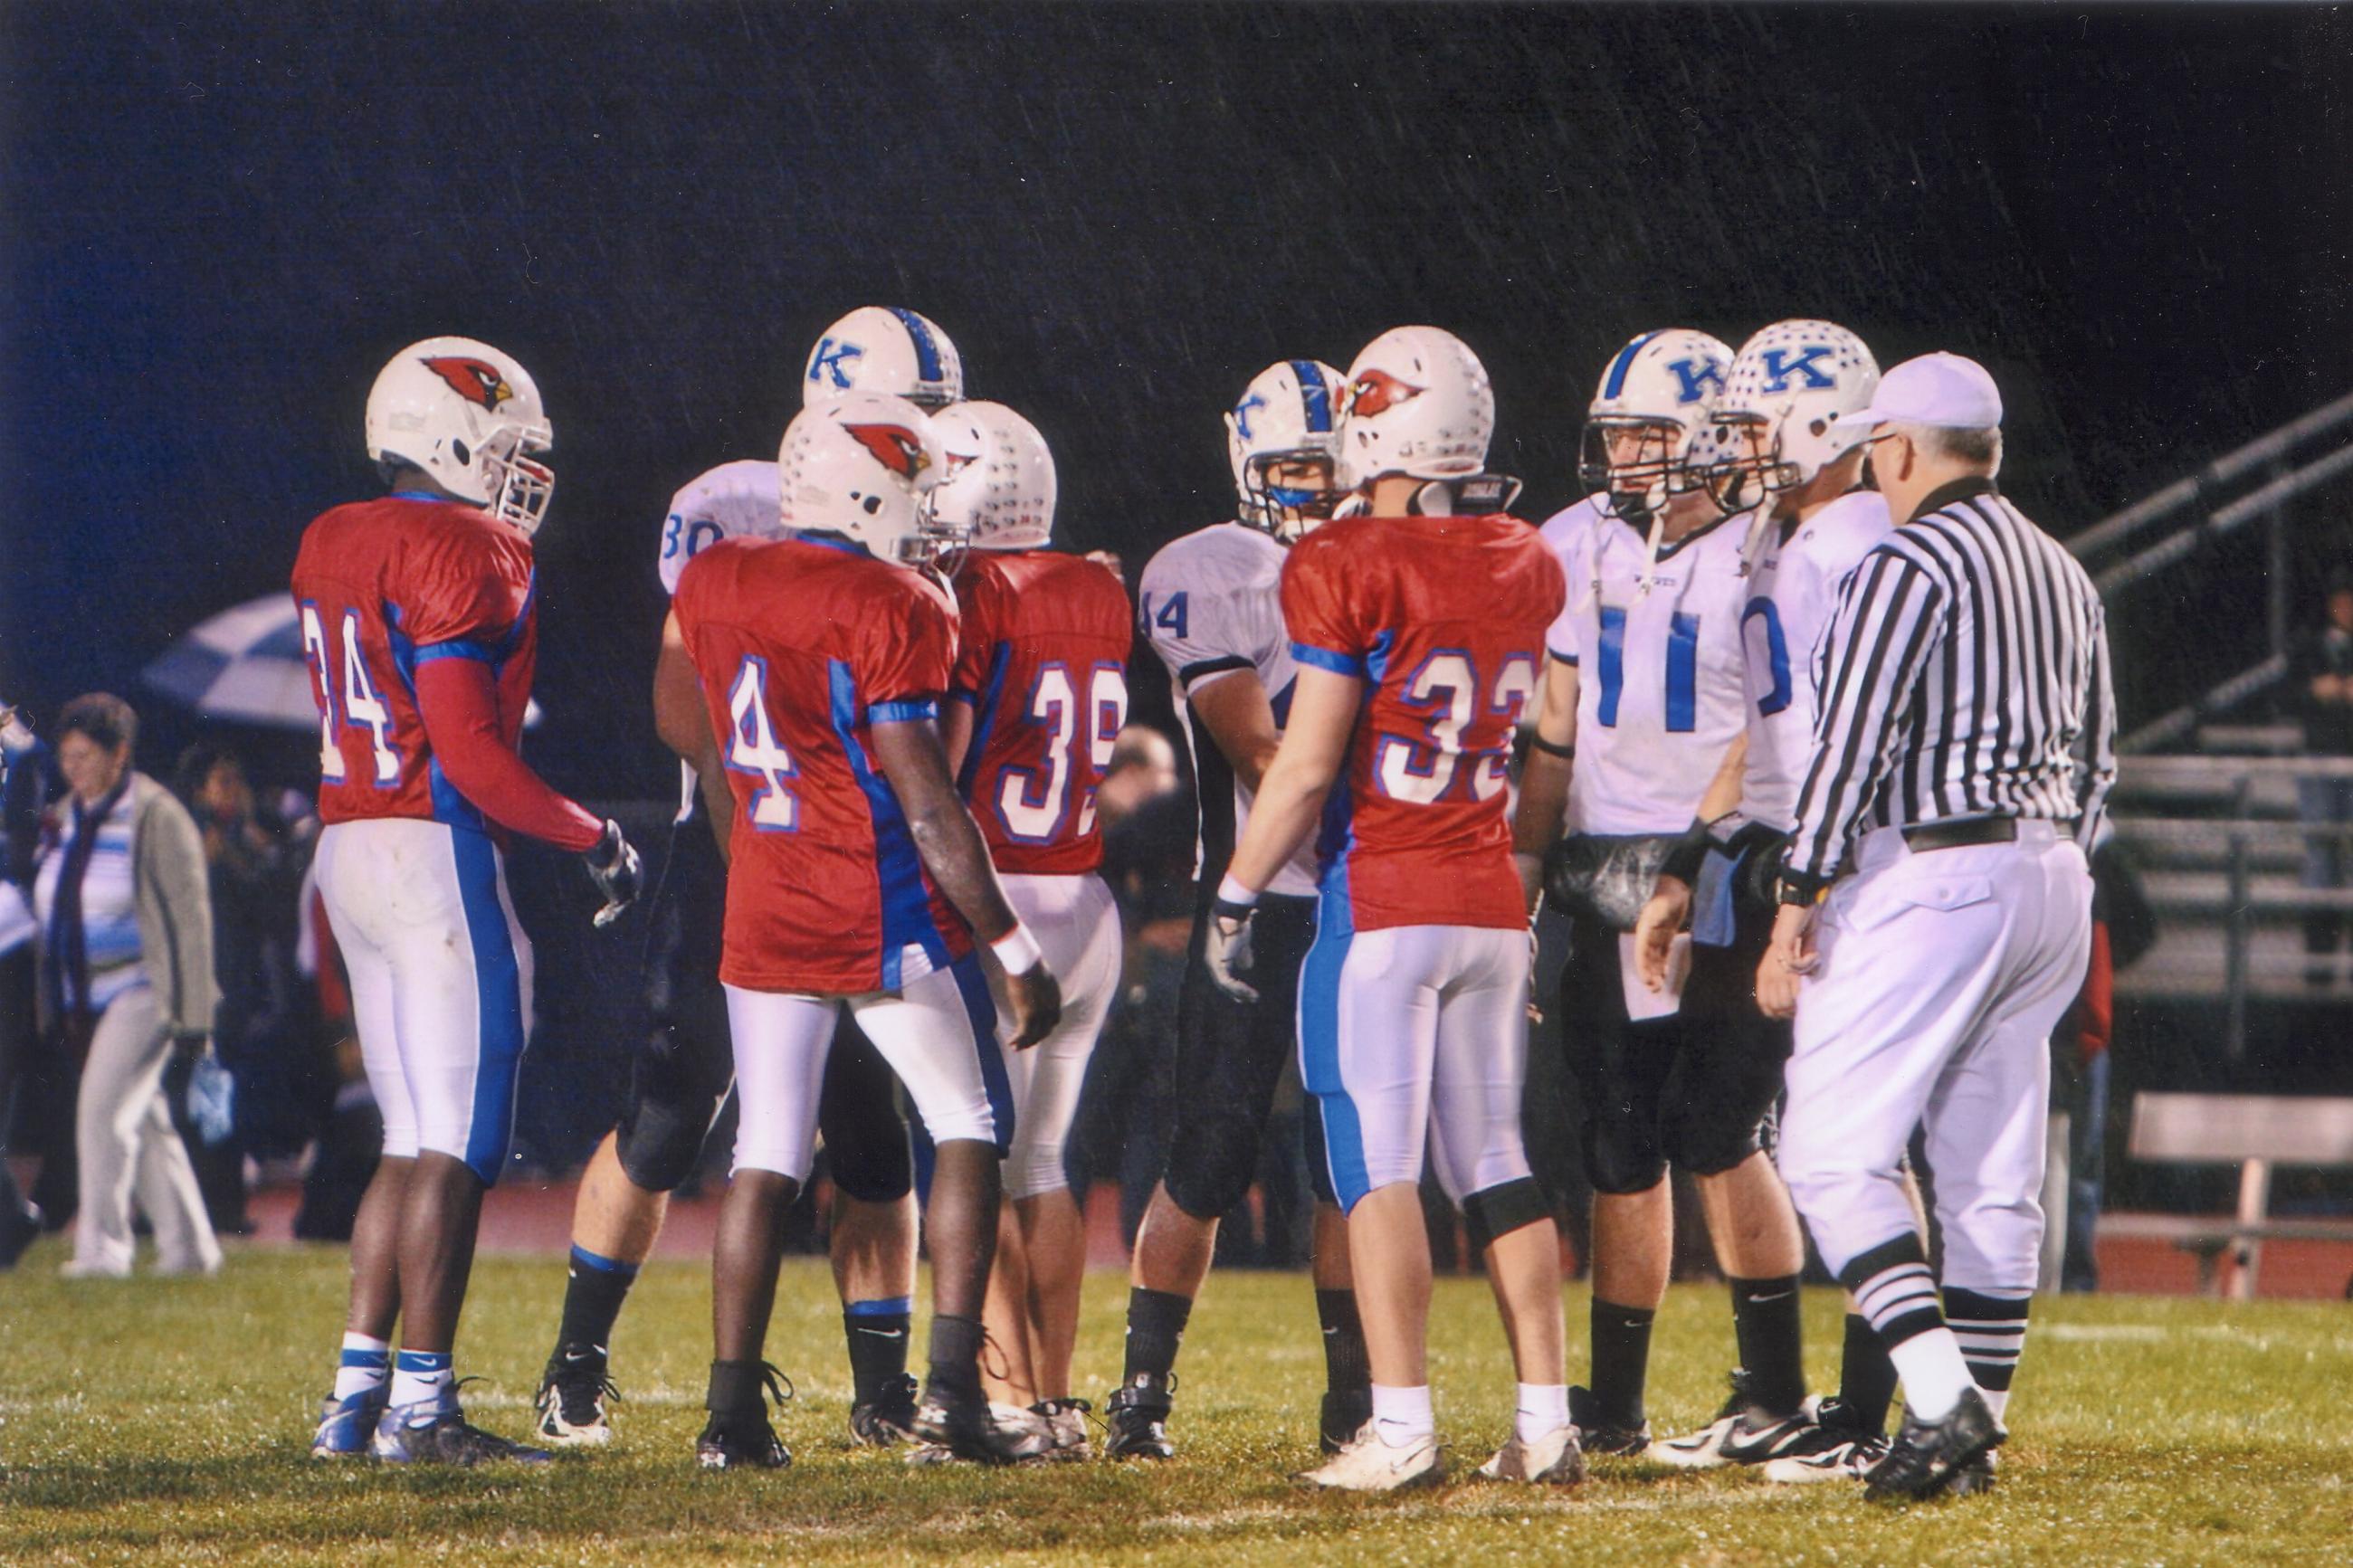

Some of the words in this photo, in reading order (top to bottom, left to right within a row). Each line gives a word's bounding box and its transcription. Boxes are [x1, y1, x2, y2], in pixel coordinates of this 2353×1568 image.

[809, 338, 862, 388] K
[1668, 356, 1724, 404] K
[1760, 347, 1834, 393] K
[1597, 605, 1700, 732] 11
[724, 652, 799, 832] 4
